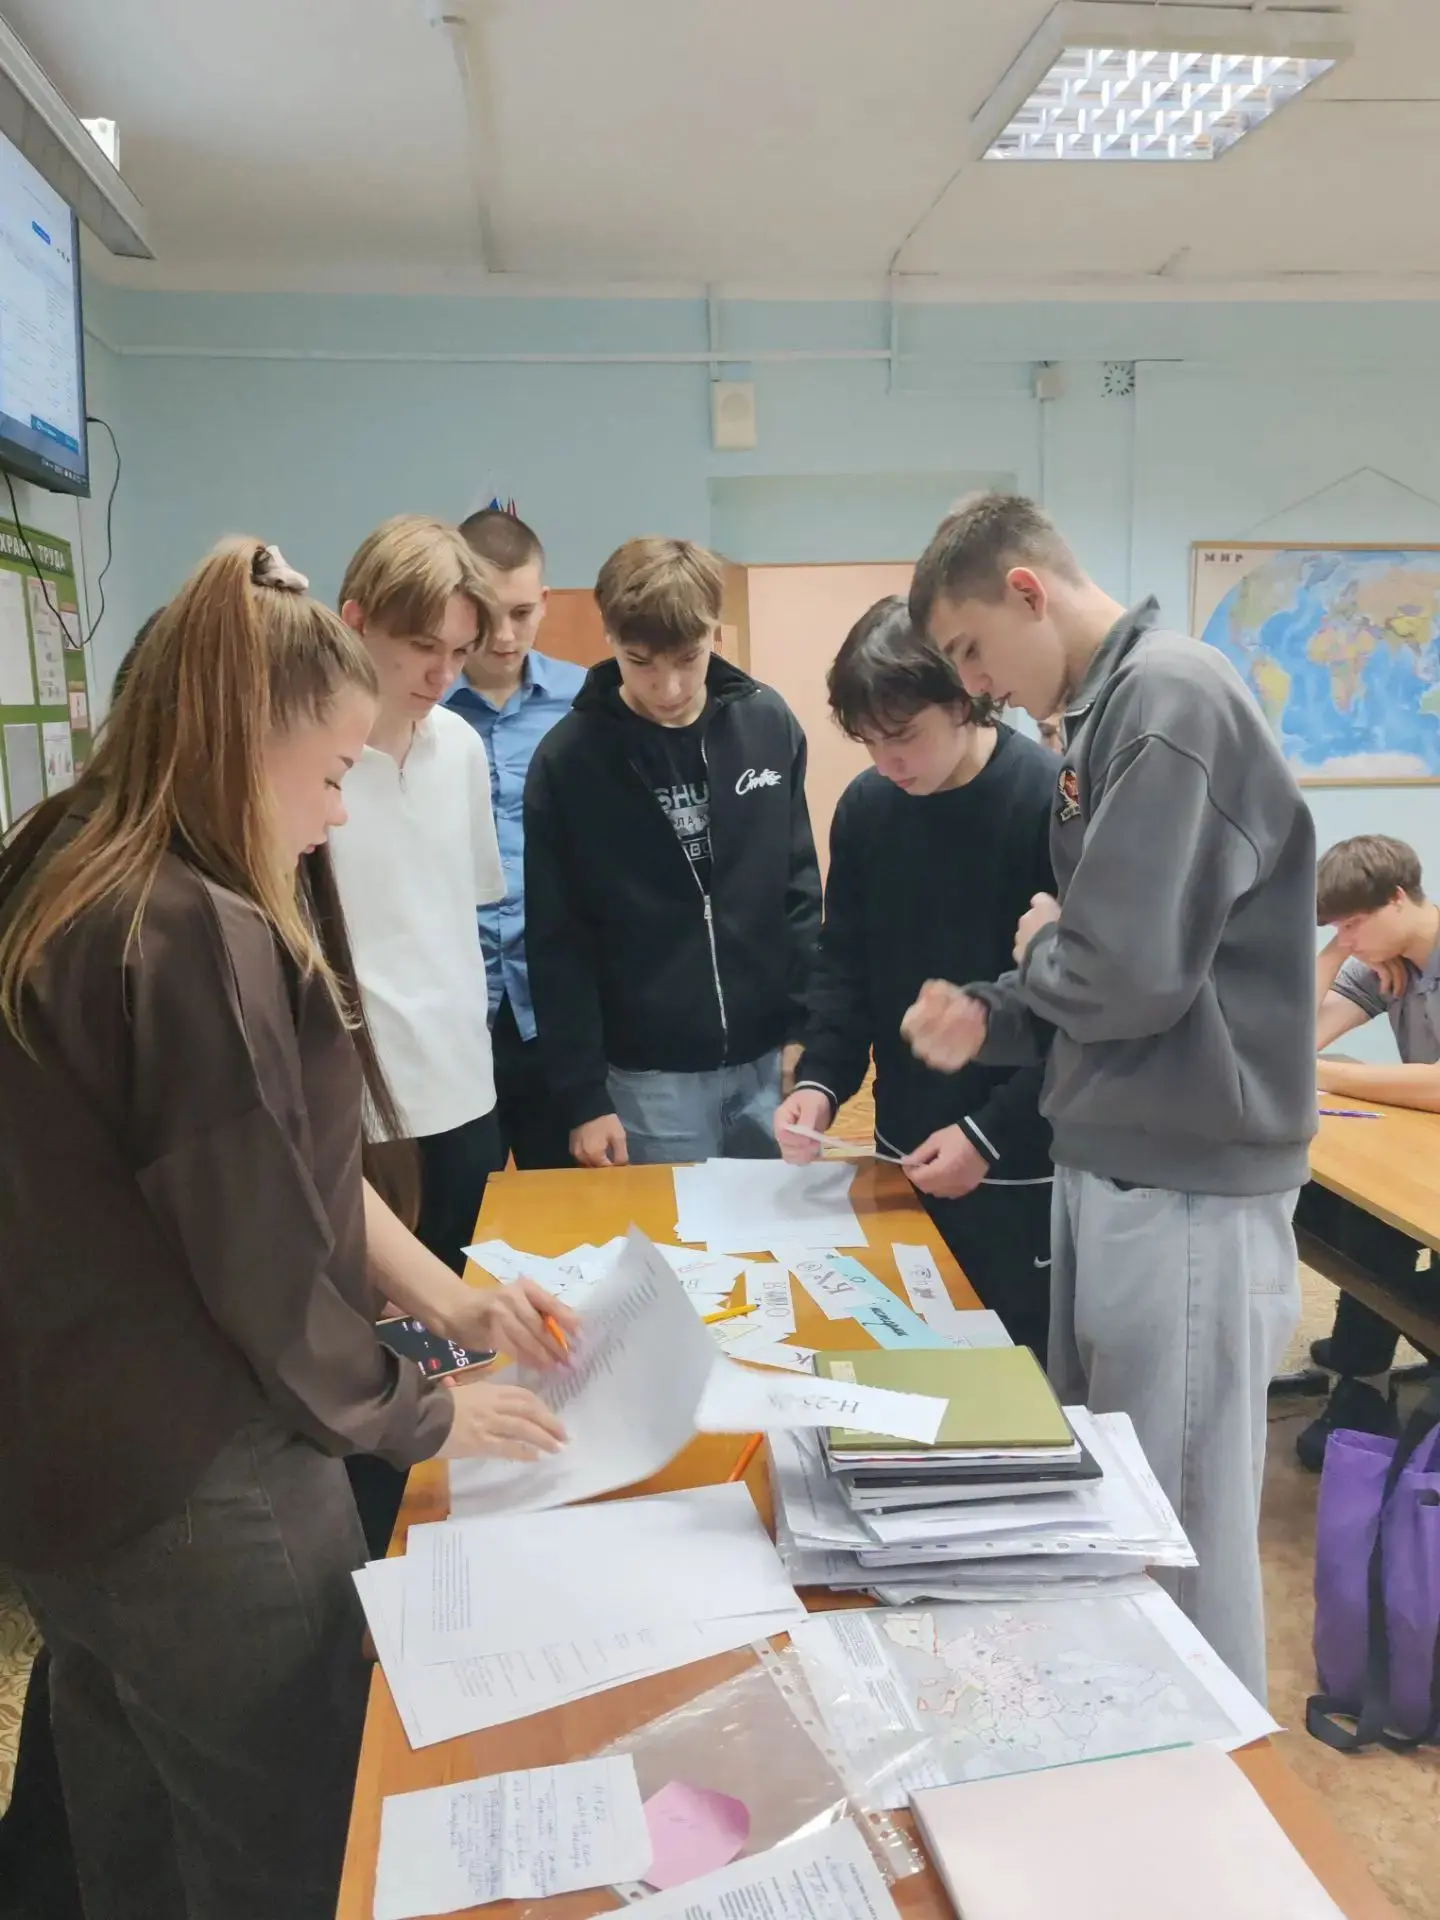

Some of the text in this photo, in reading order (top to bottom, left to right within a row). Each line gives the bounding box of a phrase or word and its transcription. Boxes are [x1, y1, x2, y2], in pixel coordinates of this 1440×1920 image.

[0, 531, 66, 570] ХРАНА ТРУДА
[1204, 552, 1244, 563] МИР
